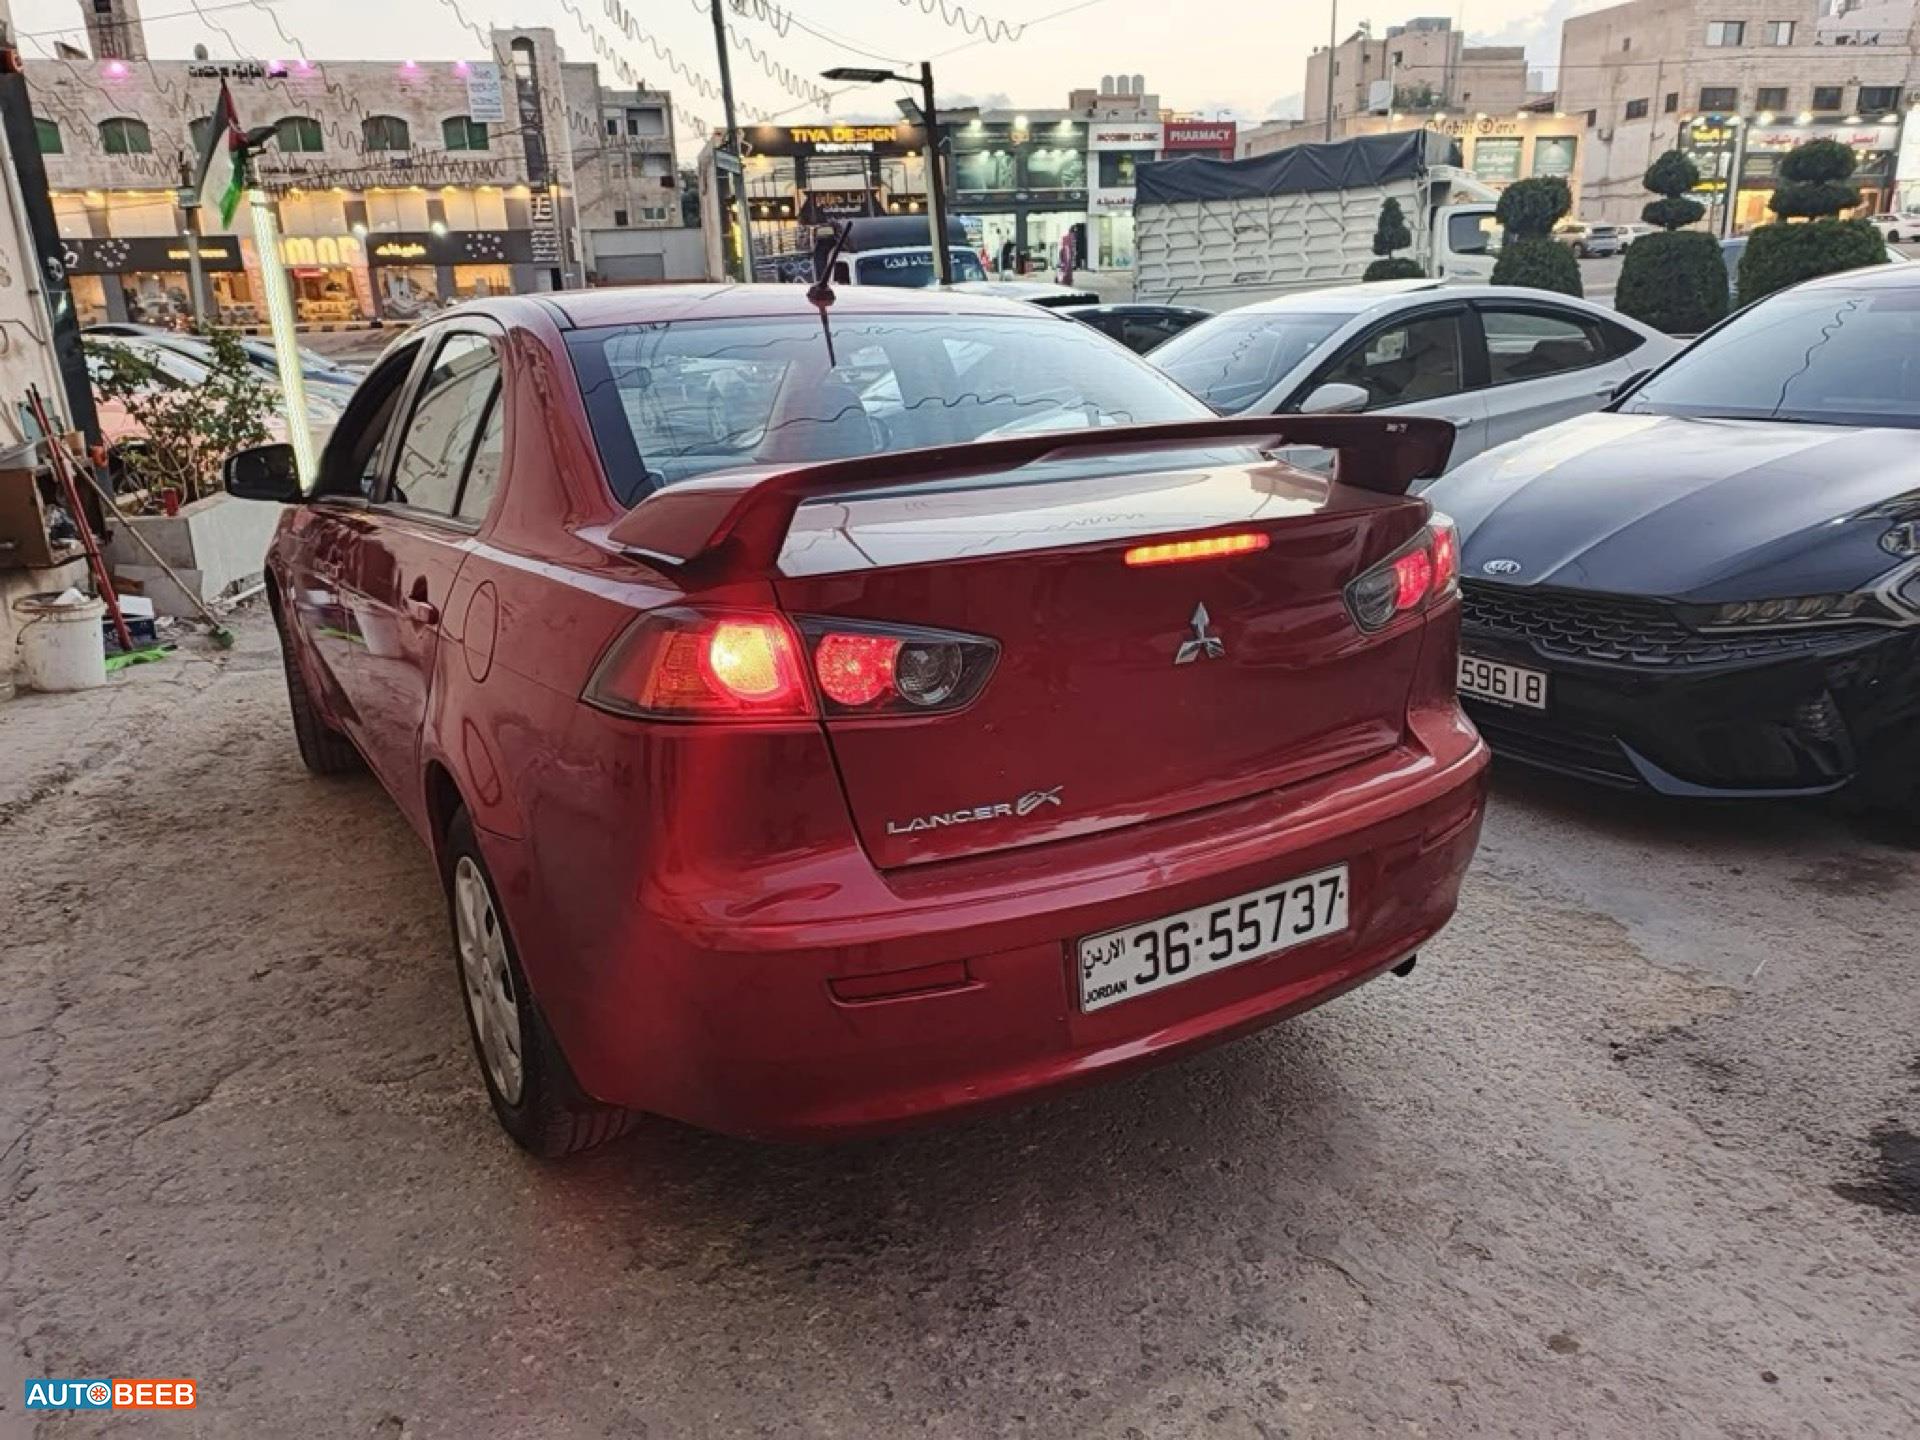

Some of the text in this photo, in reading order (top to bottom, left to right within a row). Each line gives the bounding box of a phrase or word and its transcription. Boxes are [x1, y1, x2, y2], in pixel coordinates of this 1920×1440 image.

[791, 127, 897, 142] TIVA DESIGN
[1169, 130, 1231, 142] PHARMACY
[1461, 659, 1541, 704] 59618
[887, 785, 1065, 835] LANCER EX
[1085, 979, 1128, 1004] JORDAN
